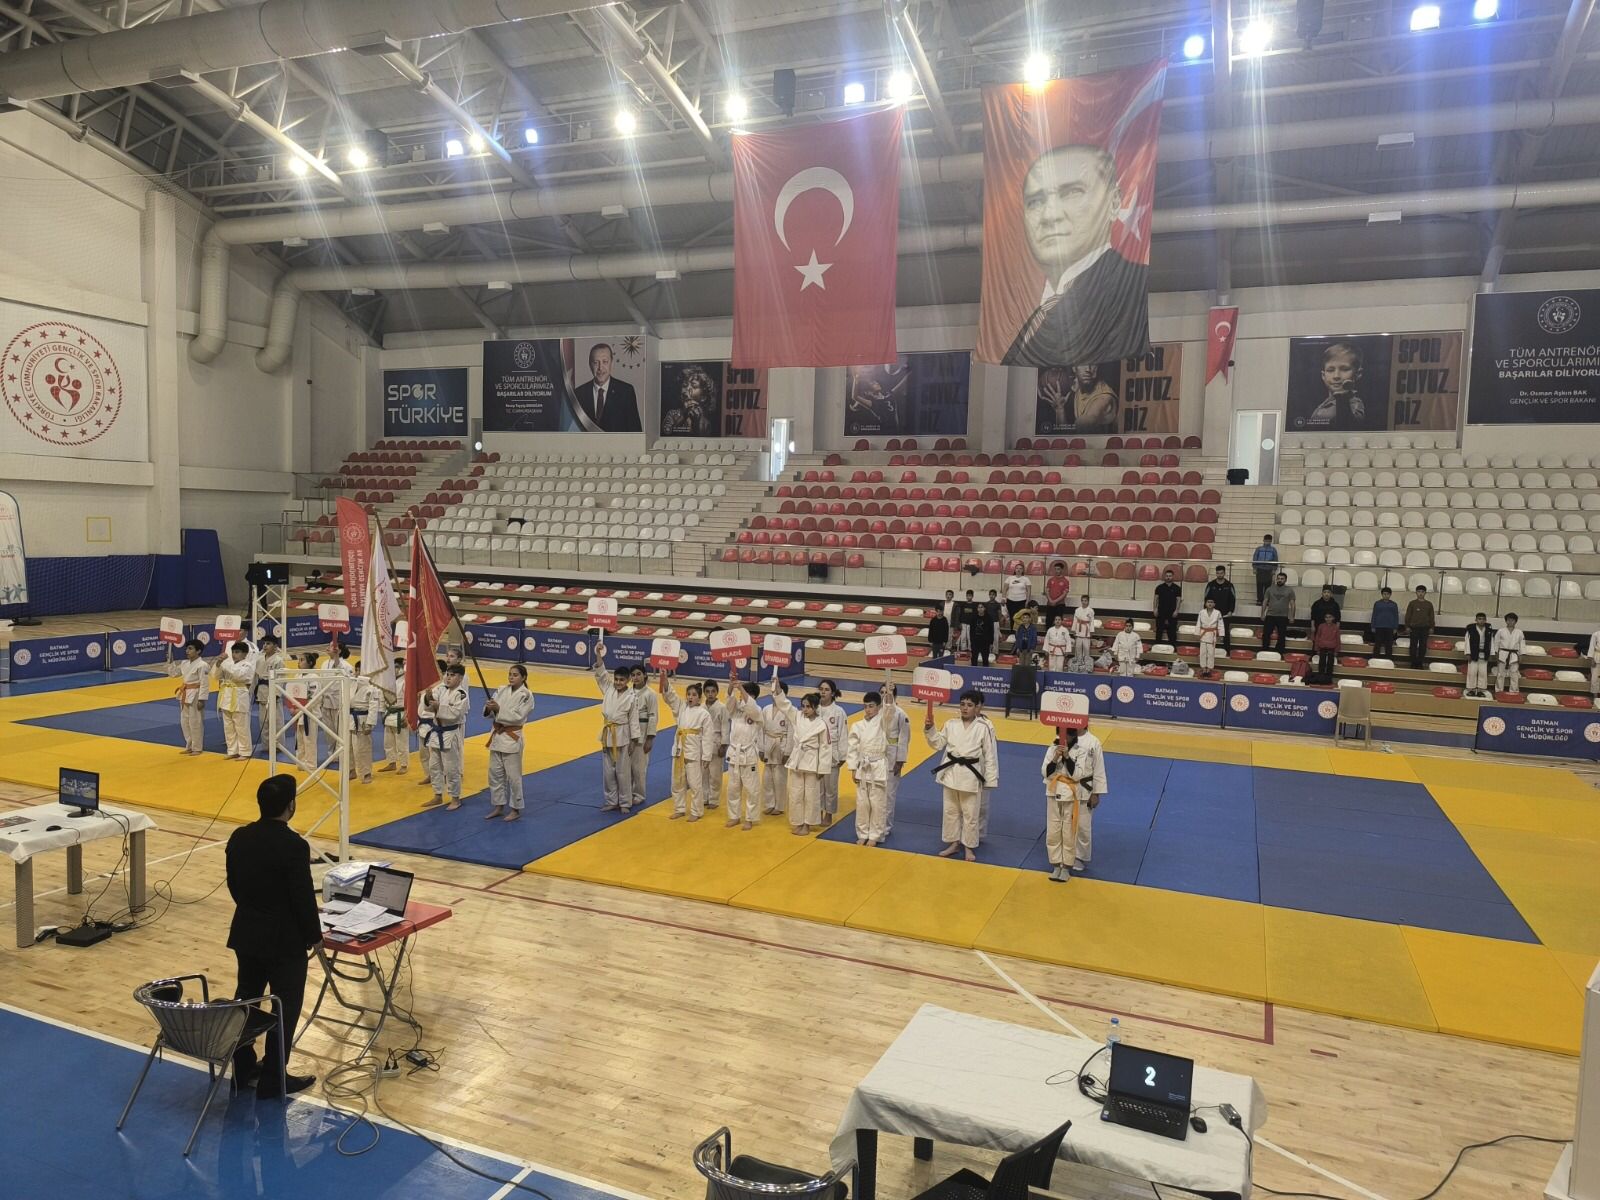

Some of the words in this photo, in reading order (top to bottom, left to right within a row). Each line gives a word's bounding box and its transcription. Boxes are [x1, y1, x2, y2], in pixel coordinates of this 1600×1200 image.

[52, 344, 84, 360] GENÇLİK
[1399, 338, 1441, 363] SPOR
[1510, 347, 1536, 358] TÜM
[24, 345, 51, 391] CUMHURİYETİ
[84, 358, 94, 368] VE
[1496, 360, 1509, 368] VE
[1512, 357, 1600, 368] SPORCULARIMI
[91, 369, 102, 389] SPOR
[1396, 369, 1449, 394] CUYUZ
[1499, 370, 1552, 380] BAŞARILAR
[388, 384, 436, 400] SPOR
[726, 389, 760, 409] CUYUZ
[1125, 376, 1172, 402] CUYUZ
[28, 395, 55, 421] TÜRKİYE
[74, 391, 102, 422] BAKANLIĞI
[388, 404, 464, 424] TÜRKİYE
[266, 569, 271, 579] 1
[918, 689, 944, 698] MALATYA
[1046, 715, 1082, 724] ADIYAMAN
[1145, 1066, 1156, 1086] 2
